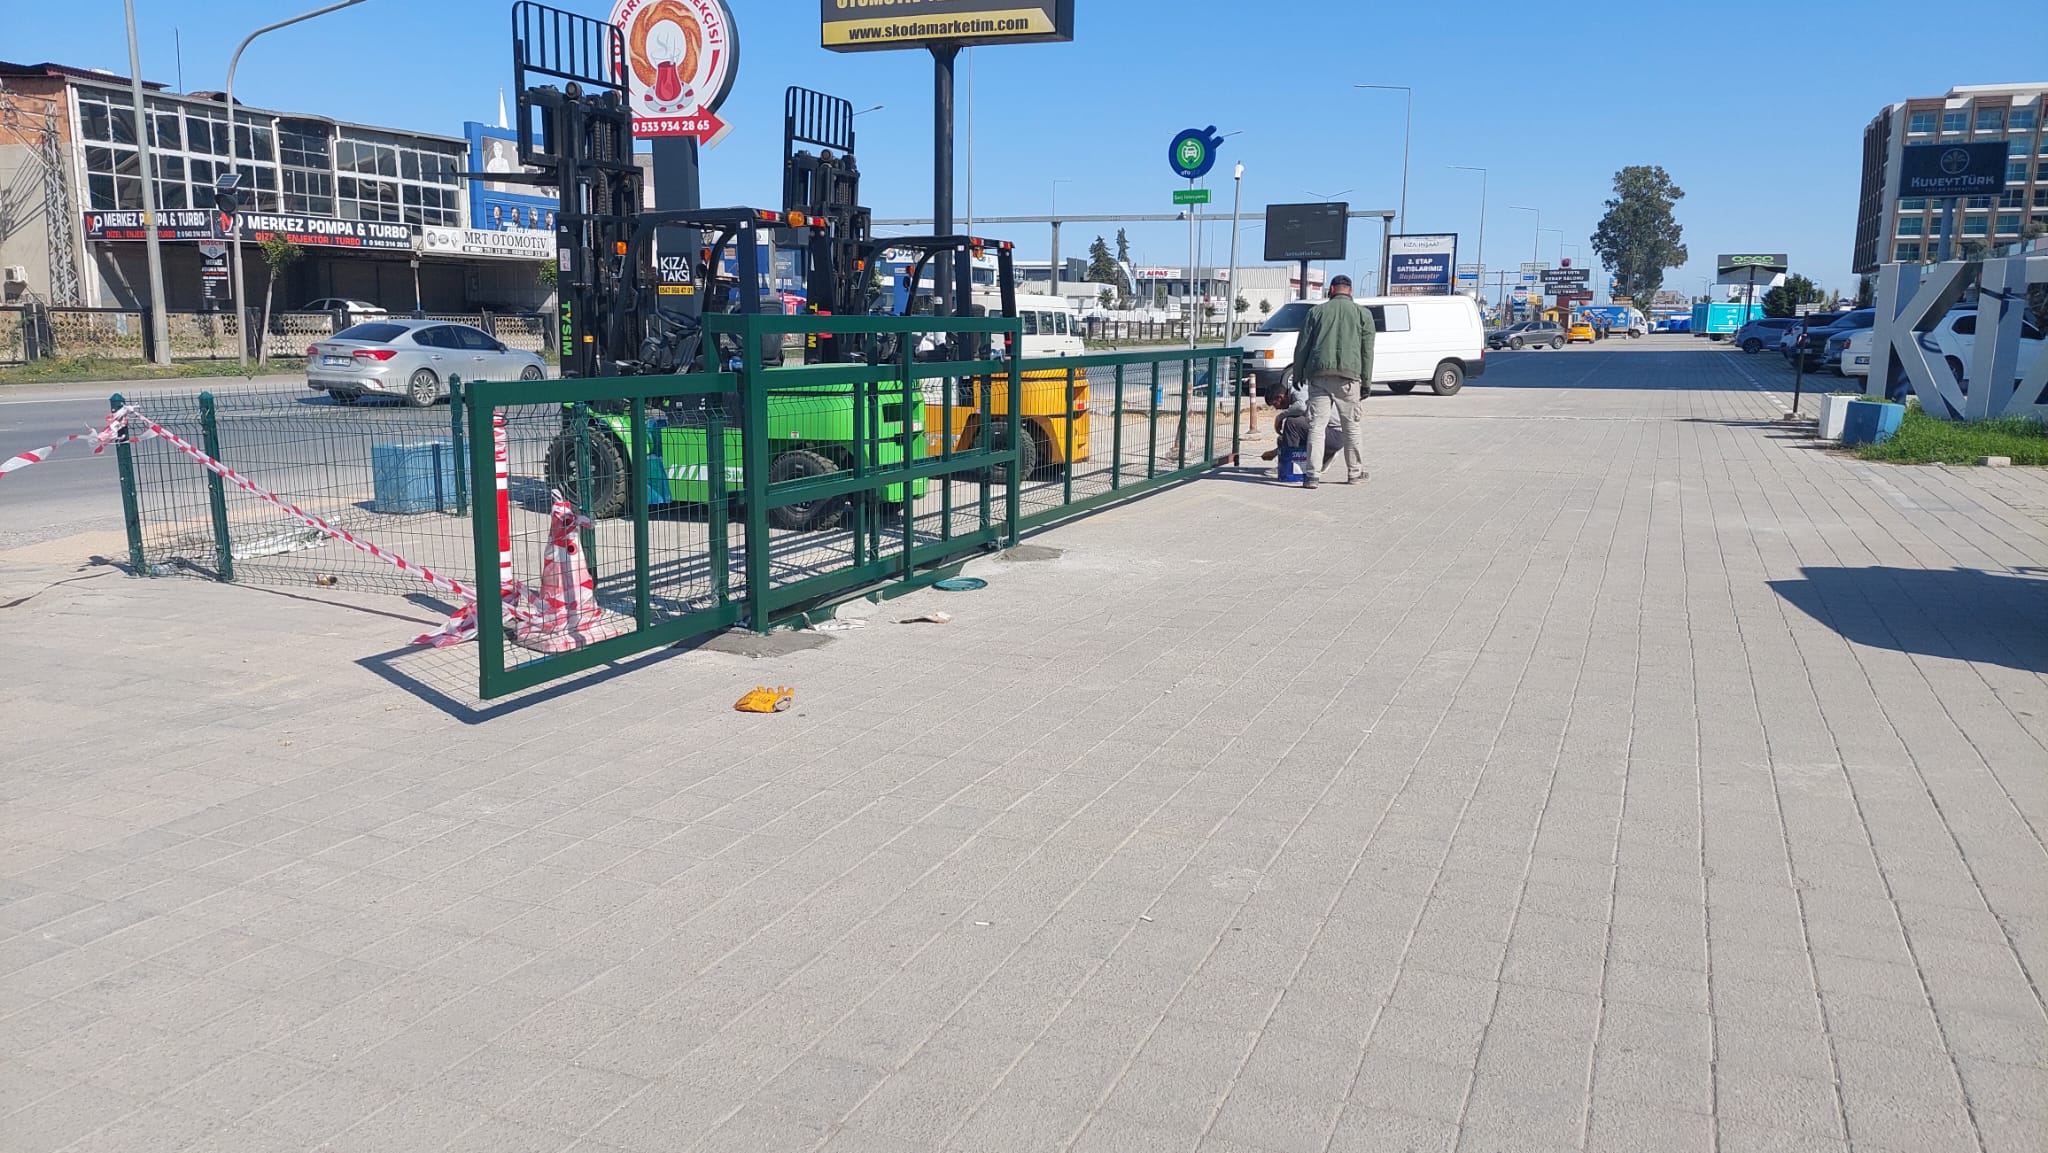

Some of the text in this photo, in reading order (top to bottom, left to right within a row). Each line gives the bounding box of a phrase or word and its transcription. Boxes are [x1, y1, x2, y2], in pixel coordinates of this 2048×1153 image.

[849, 17, 1029, 40] www.skodamarketim.com
[632, 120, 710, 132] 0 533 934 28 65
[104, 213, 138, 226] MERKEZ
[178, 211, 205, 226] TURBO
[248, 216, 408, 239] MERKEZ POMPA & TURBO
[335, 238, 361, 246] TURBO
[464, 231, 489, 245] MRT
[660, 256, 689, 270] KIZA
